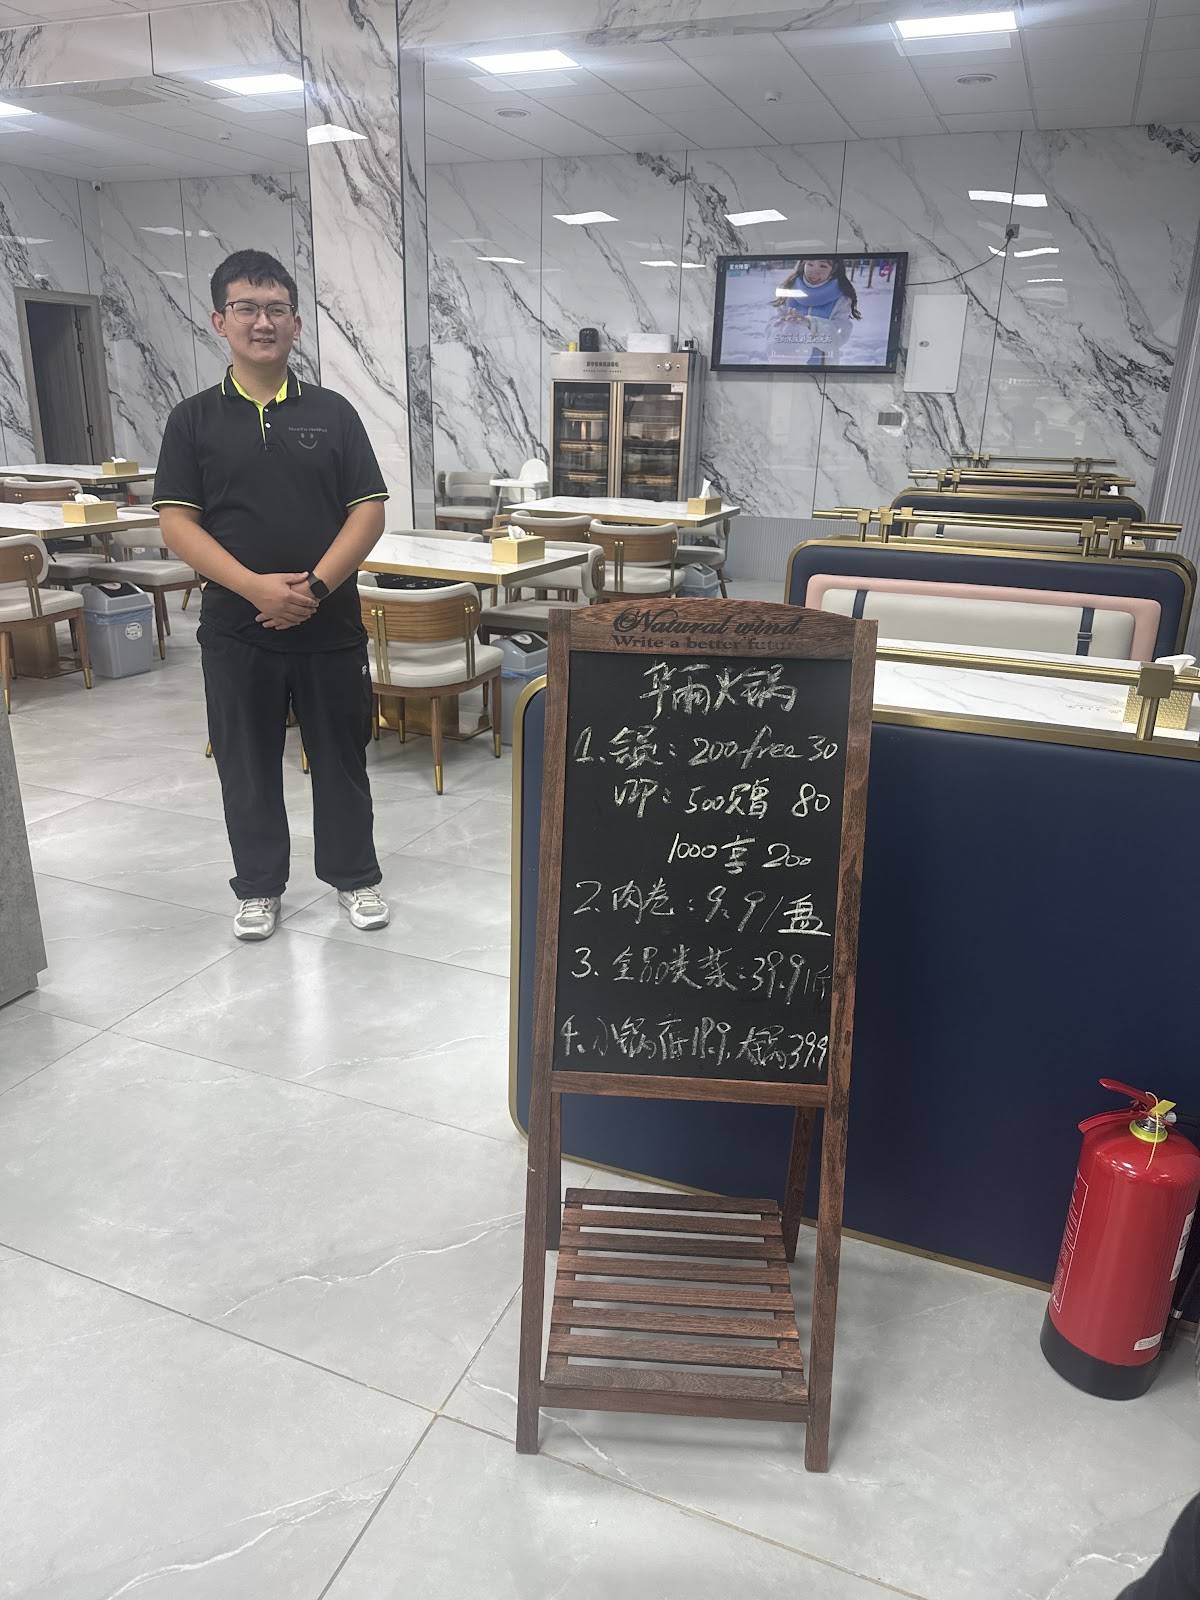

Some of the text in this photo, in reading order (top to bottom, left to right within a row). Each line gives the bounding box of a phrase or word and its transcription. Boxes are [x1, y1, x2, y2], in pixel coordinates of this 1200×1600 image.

[613, 608, 803, 636] Natural wind
[611, 635, 664, 649] Write
[670, 638, 679, 649] a
[686, 637, 739, 650] better
[687, 737, 738, 767] 200
[737, 723, 804, 770] free
[807, 734, 839, 762] 30
[790, 782, 831, 819] 80
[761, 842, 812, 868] 200
